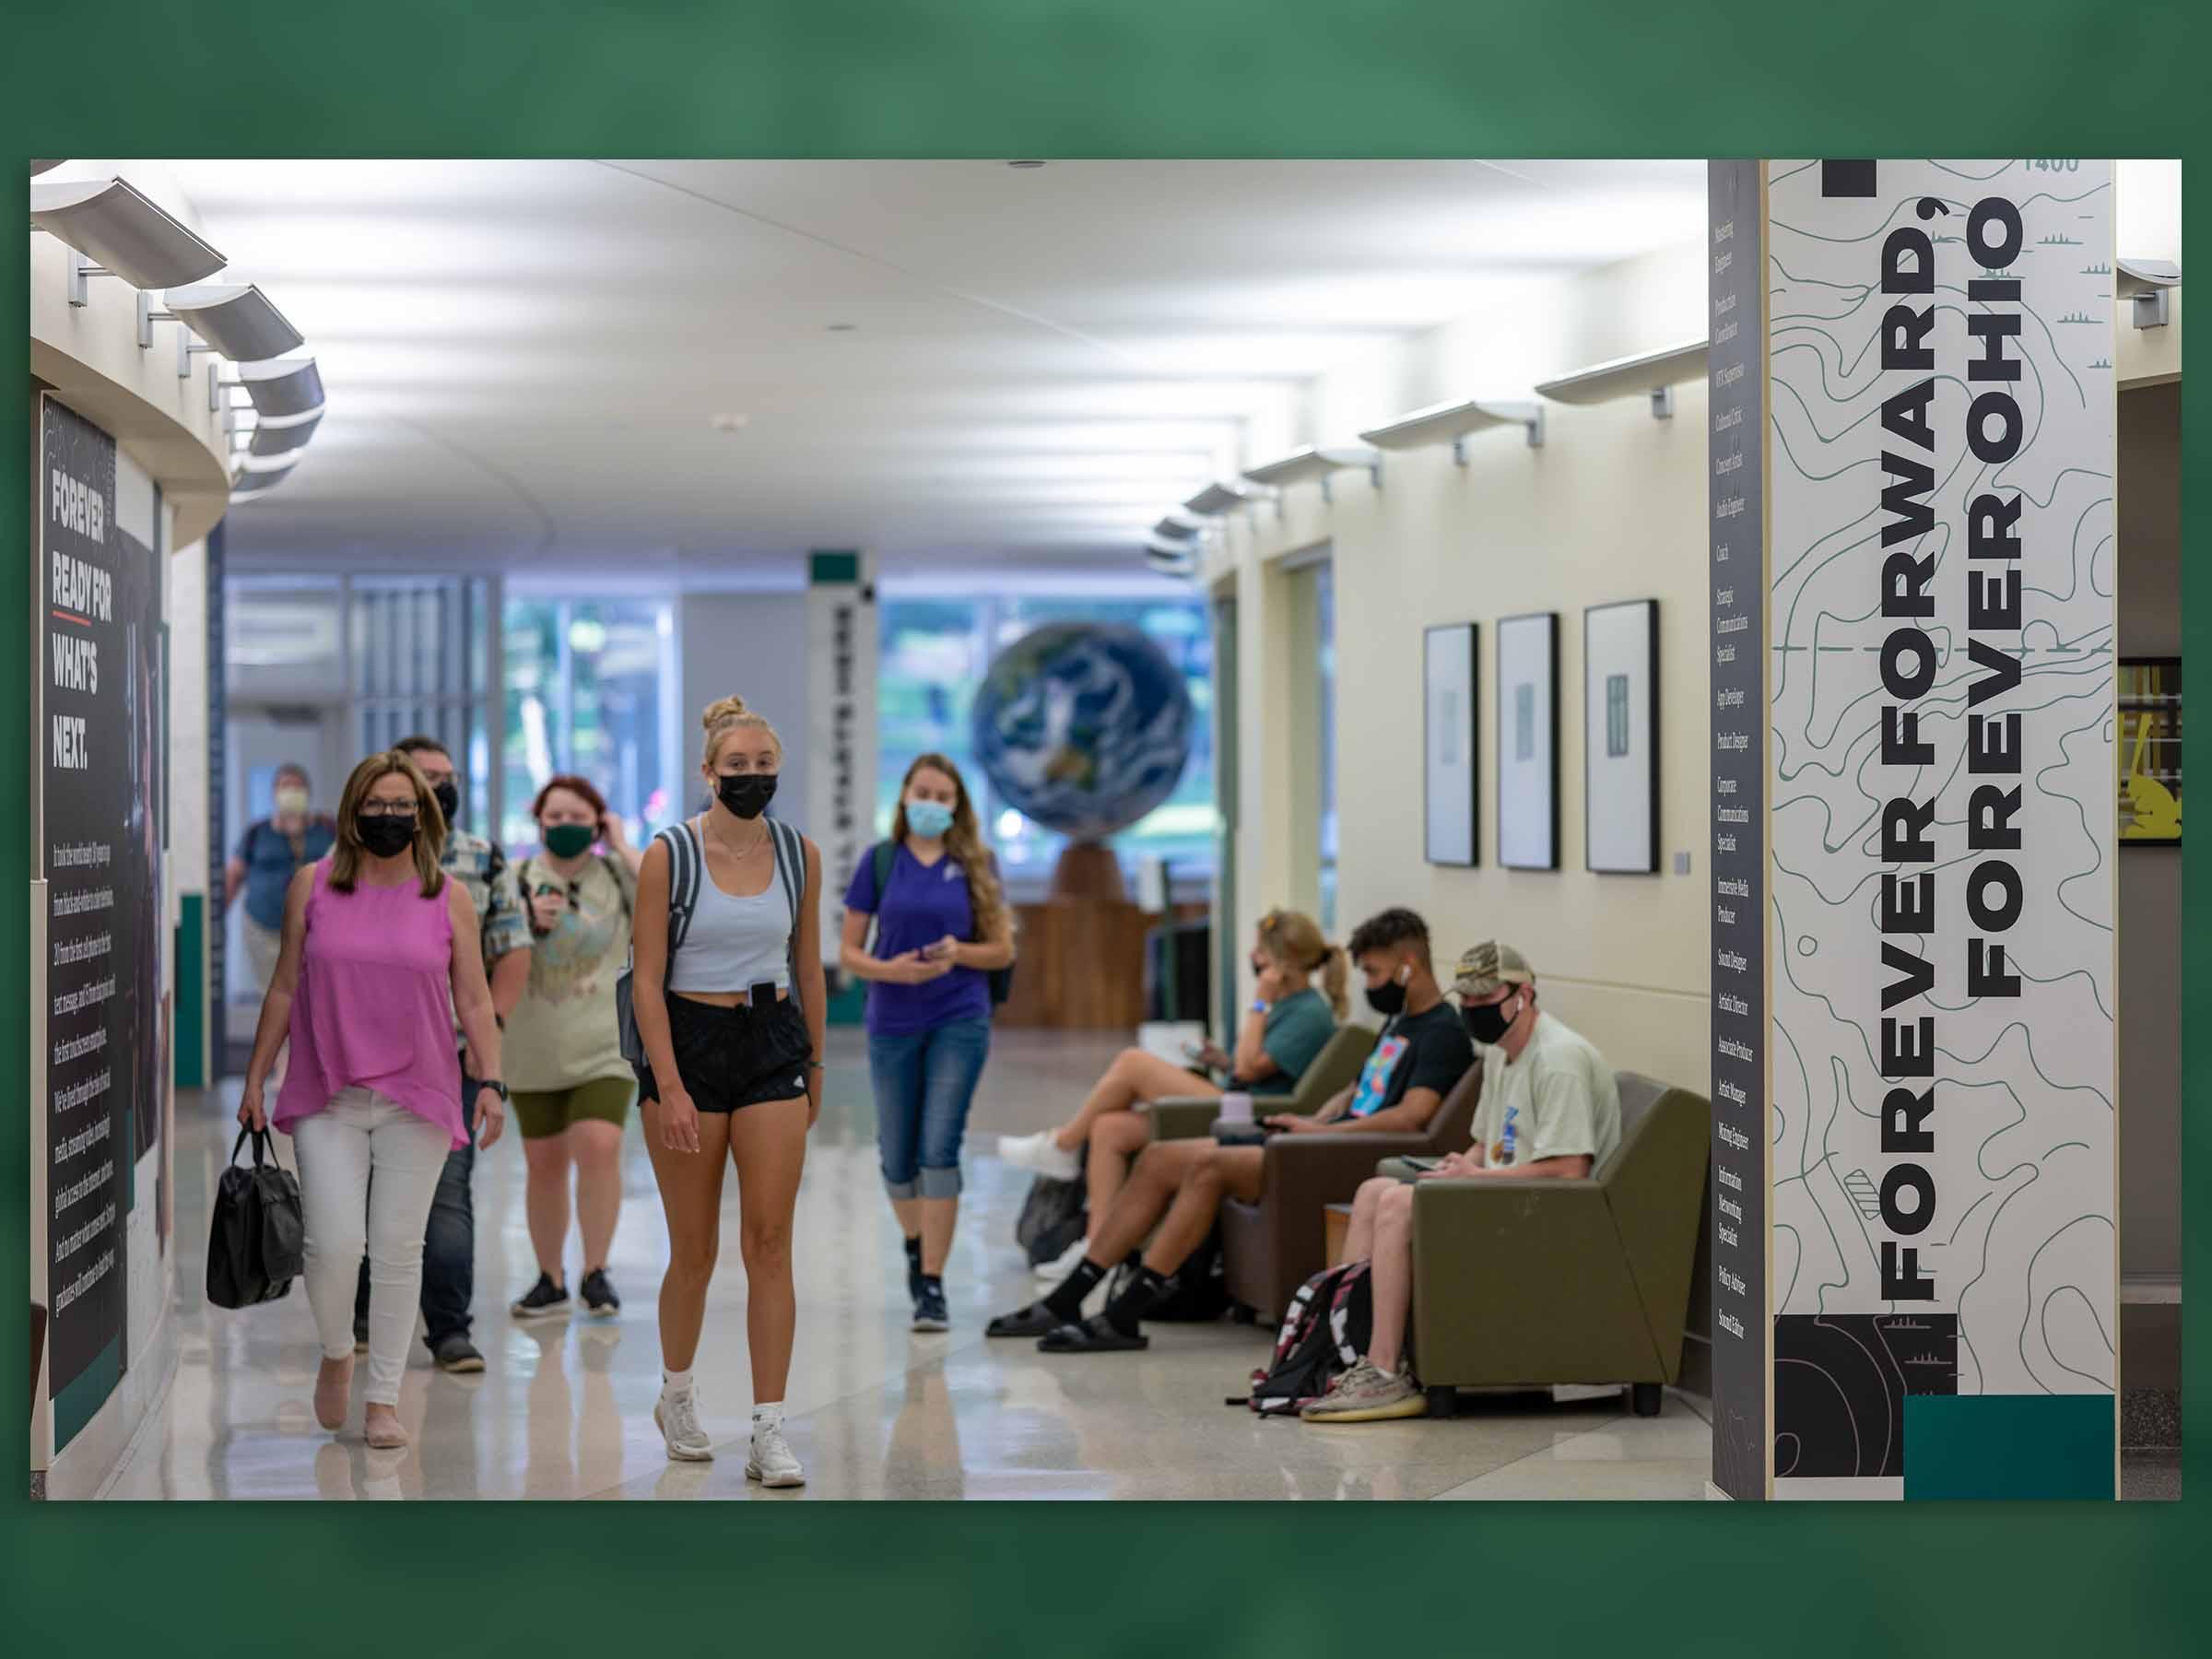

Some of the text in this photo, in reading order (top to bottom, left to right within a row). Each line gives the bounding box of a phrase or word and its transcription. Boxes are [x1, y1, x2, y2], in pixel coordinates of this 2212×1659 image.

[53, 468, 104, 545] FOREVER
[1717, 542, 1729, 562] Coach
[53, 552, 112, 623] READY FOR
[1717, 585, 1734, 608] Strategic
[1966, 196, 2024, 997] FOREVER OHIO
[53, 631, 98, 696] WHAT'S
[1717, 688, 1745, 710] App Developer
[53, 714, 88, 771] NEXT.
[1718, 731, 1748, 752] Product Designer
[1879, 196, 1950, 1301] FOREVER FORWARD,
[1718, 775, 1736, 796] Corporate
[1718, 804, 1749, 823] Communications
[1718, 833, 1736, 854] Specialist
[1718, 877, 1749, 897] Immersive Media
[1718, 905, 1735, 924] Producer
[1718, 947, 1747, 973] Sound Designer
[1718, 993, 1748, 1016] Artistic Director
[1718, 1034, 1753, 1062] Associate Producer
[1718, 1078, 1747, 1106] Artist Manager
[1719, 1121, 1748, 1150] Mixing Engineer
[1719, 1165, 1742, 1192] Information
[1719, 1194, 1742, 1224] Networking
[1719, 1222, 1738, 1247] Specialist
[1719, 1265, 1731, 1290] Policy
[1719, 1308, 1745, 1339] Sound Editor
